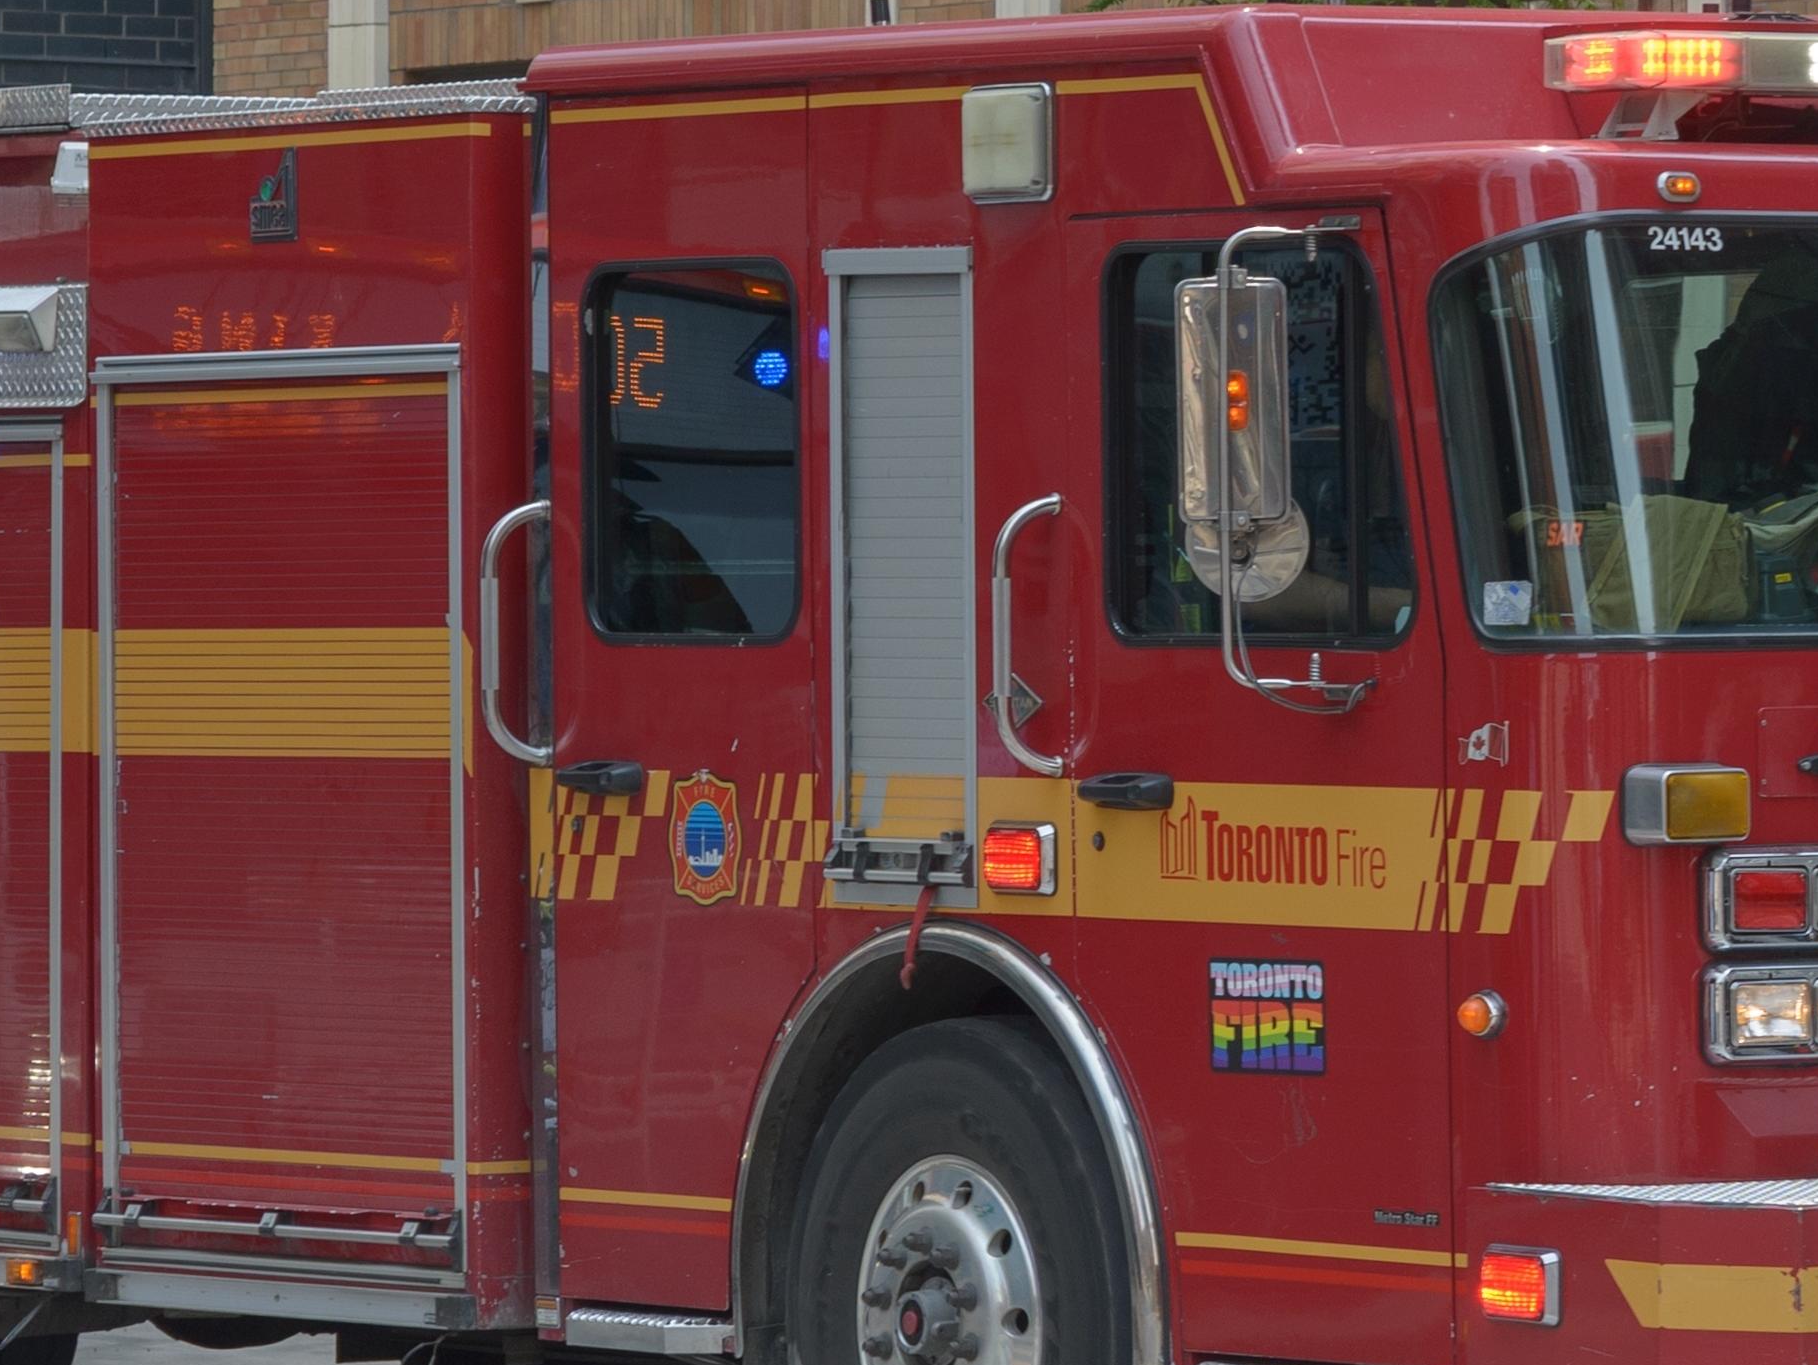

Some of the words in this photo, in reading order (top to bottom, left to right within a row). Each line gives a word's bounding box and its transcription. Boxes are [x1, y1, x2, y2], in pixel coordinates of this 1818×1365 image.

[1646, 225, 1724, 252] 24143
[1336, 828, 1386, 889] Fire
[1209, 961, 1323, 999] TORONTO
[1211, 999, 1324, 1072] FIRE
